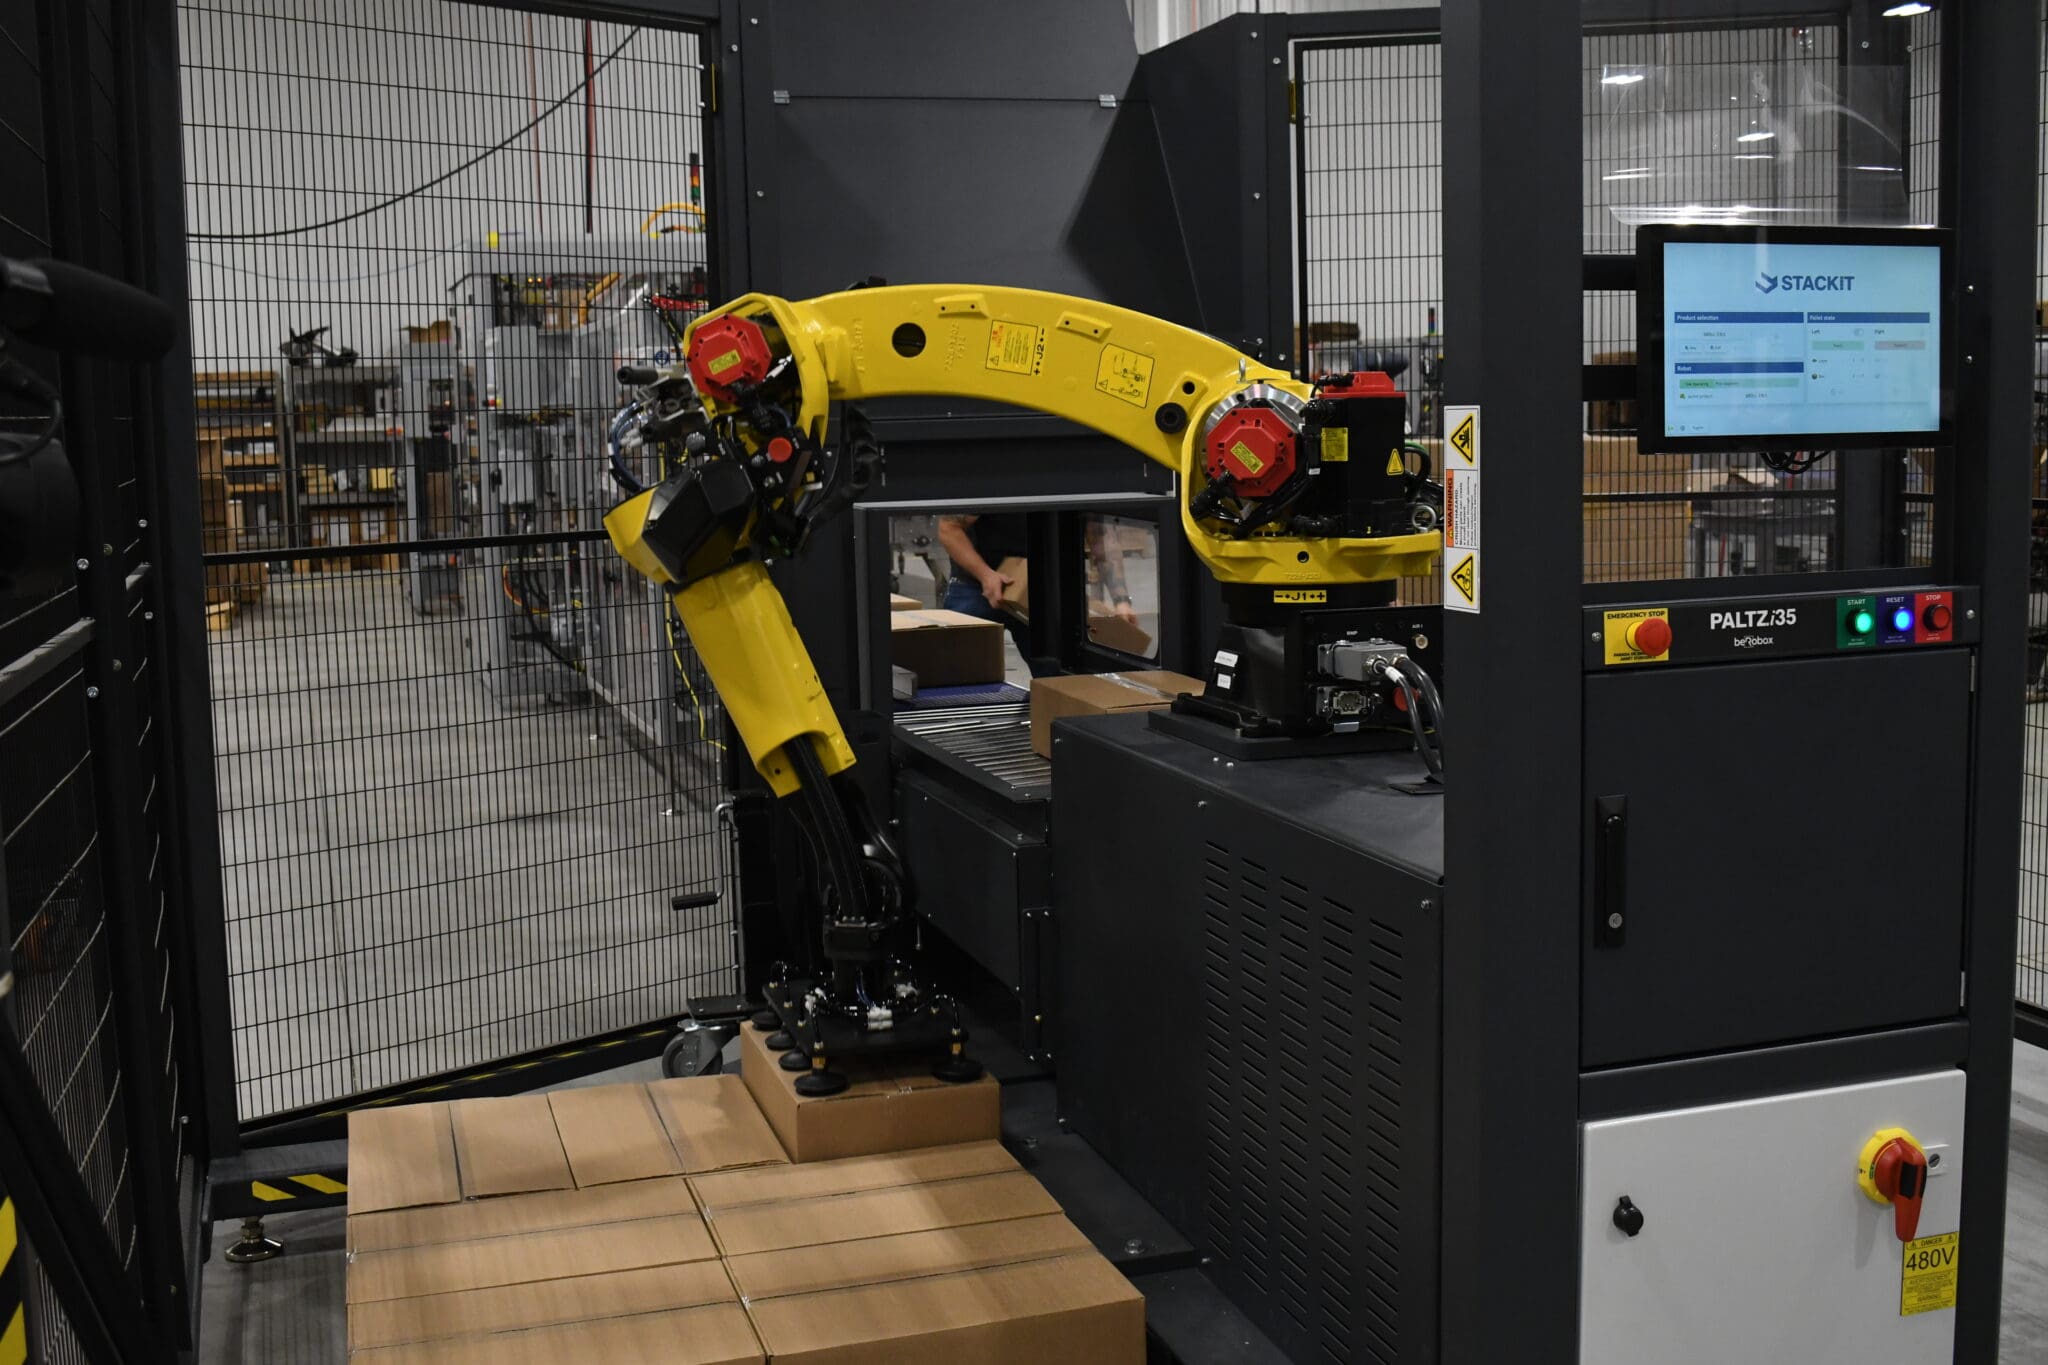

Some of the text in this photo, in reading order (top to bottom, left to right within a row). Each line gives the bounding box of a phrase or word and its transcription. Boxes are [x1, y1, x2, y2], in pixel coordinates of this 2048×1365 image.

[1781, 275, 1855, 291] STACKIT
[1036, 343, 1045, 360] J2
[1291, 592, 1307, 601] J1
[1847, 598, 1866, 606] START
[1607, 611, 1647, 620] EMERGENCY
[1906, 1246, 1956, 1271] 480V
